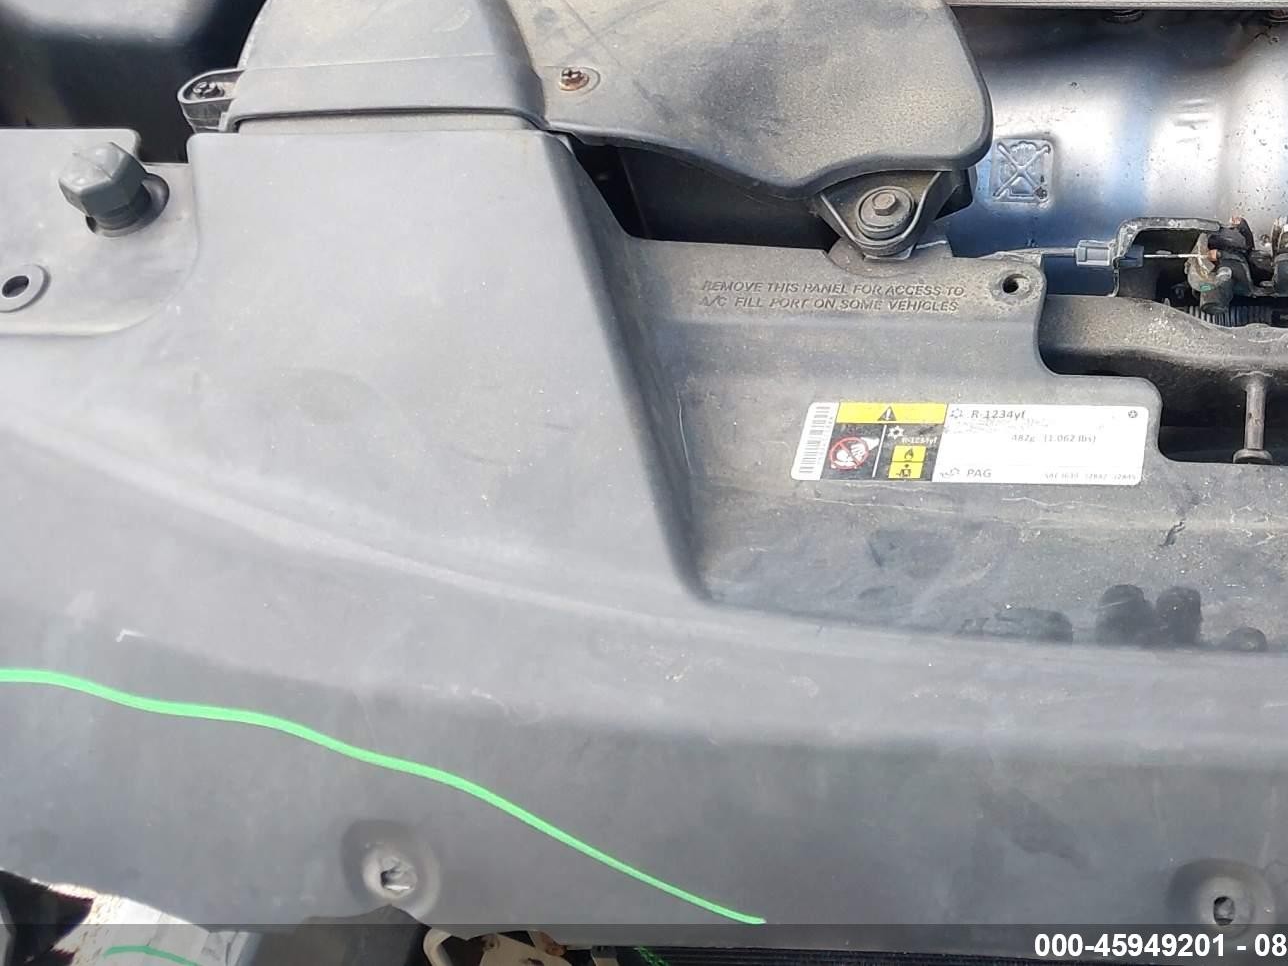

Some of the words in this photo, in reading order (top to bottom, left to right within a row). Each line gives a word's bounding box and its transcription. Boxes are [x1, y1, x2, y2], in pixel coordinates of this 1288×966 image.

[701, 280, 762, 292] REMOVE
[767, 282, 799, 293] THIS
[803, 283, 847, 294] PANEL
[853, 284, 881, 295] FOR
[885, 285, 941, 296] ACCESS
[946, 286, 965, 296] TO
[700, 296, 727, 307] A/C
[734, 297, 764, 308] FILL
[769, 298, 807, 308] PORT
[814, 298, 835, 309] ON
[841, 299, 882, 310] SOME
[889, 300, 958, 311] VEHICLES
[970, 409, 1026, 421] R-1234yf
[967, 468, 992, 478] PAG
